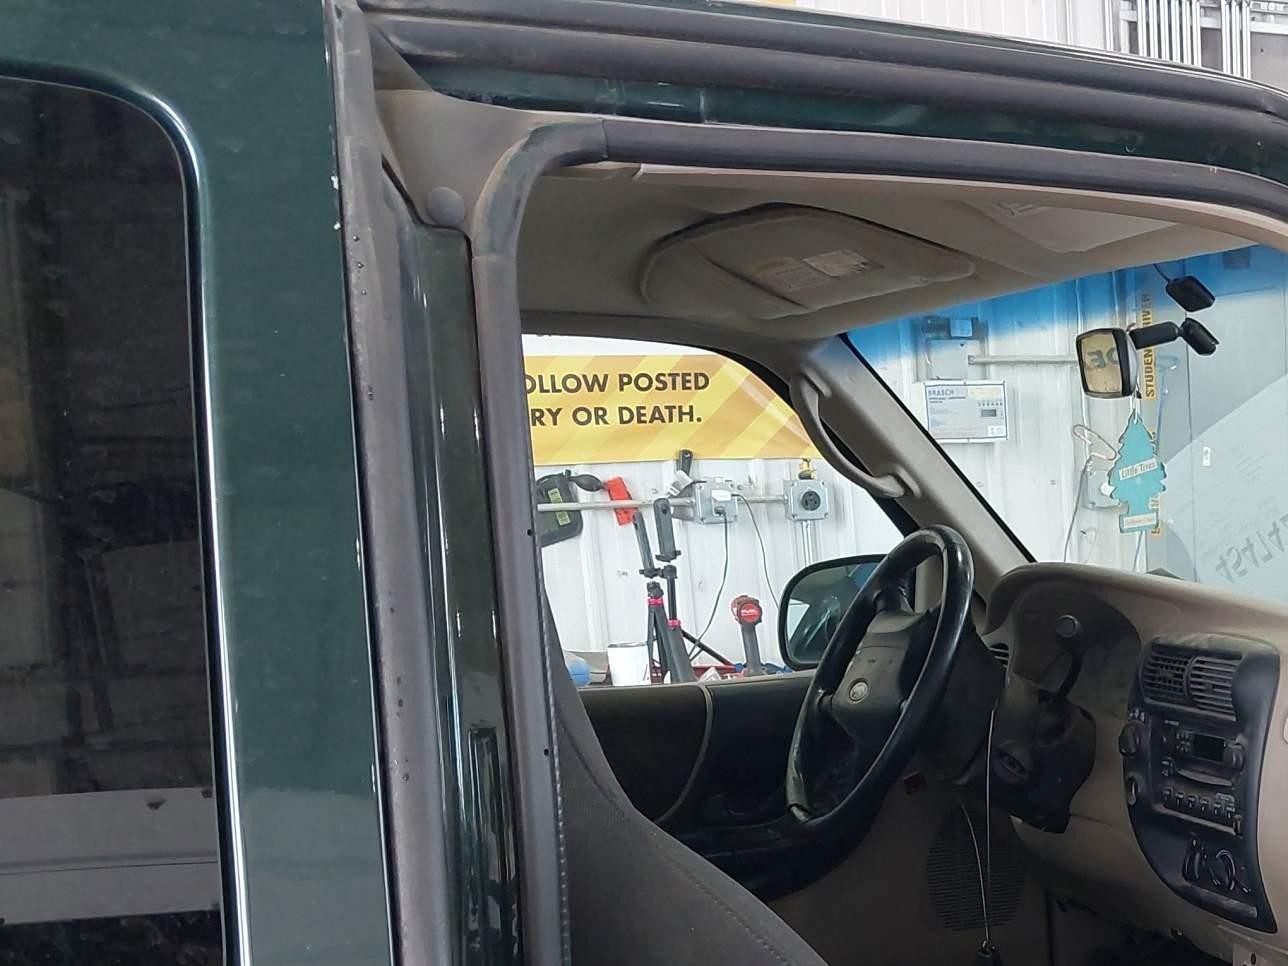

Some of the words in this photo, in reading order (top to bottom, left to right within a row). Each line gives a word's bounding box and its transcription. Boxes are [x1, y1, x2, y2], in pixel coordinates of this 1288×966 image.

[618, 371, 710, 392] POSTED
[530, 406, 563, 427] RY
[571, 406, 610, 426] OR
[617, 404, 703, 425] DEATH.
